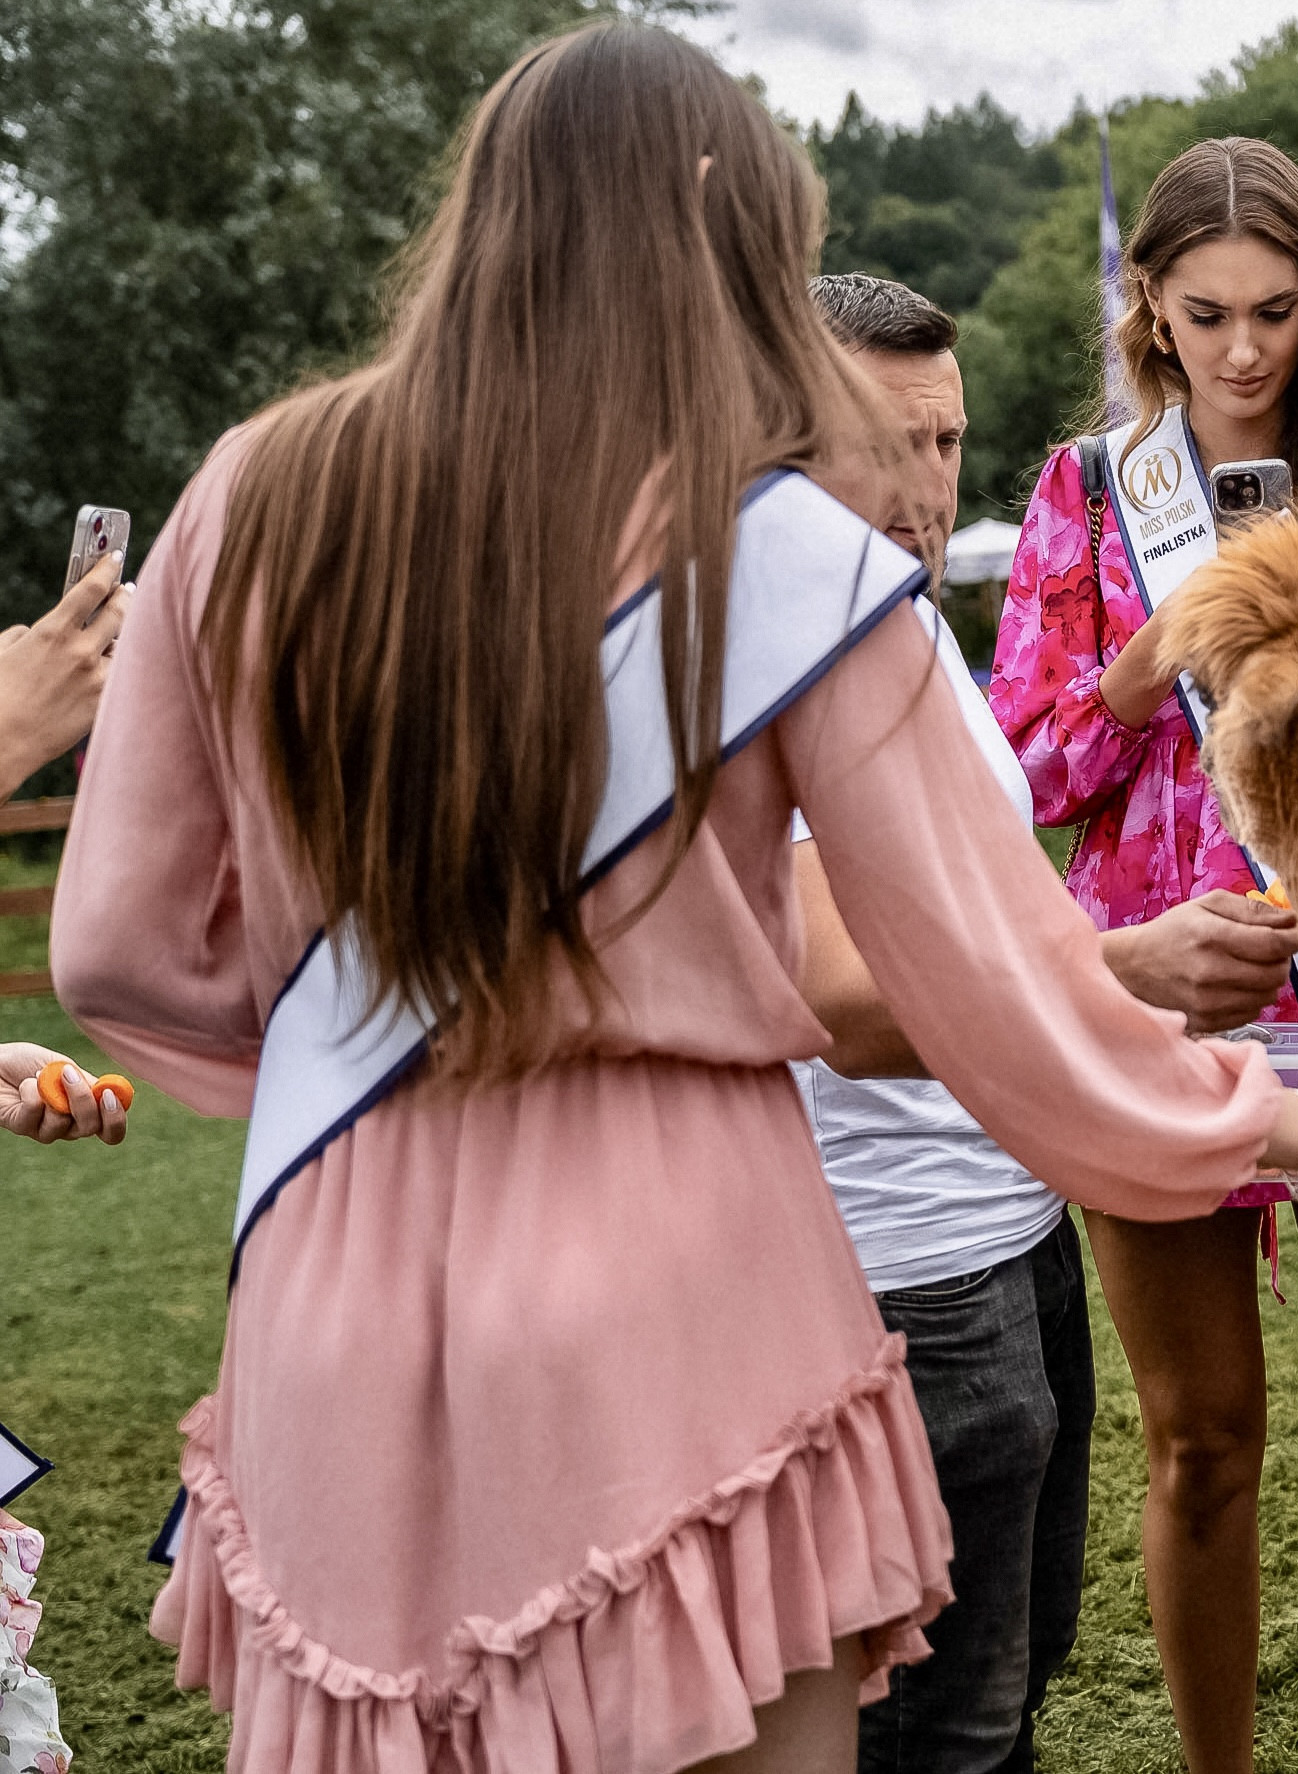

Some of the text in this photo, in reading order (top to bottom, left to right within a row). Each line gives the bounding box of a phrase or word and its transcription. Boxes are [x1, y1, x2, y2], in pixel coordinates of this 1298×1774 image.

[1139, 498, 1197, 541] MISS POLSKI
[1143, 523, 1207, 564] FINALISTKA
